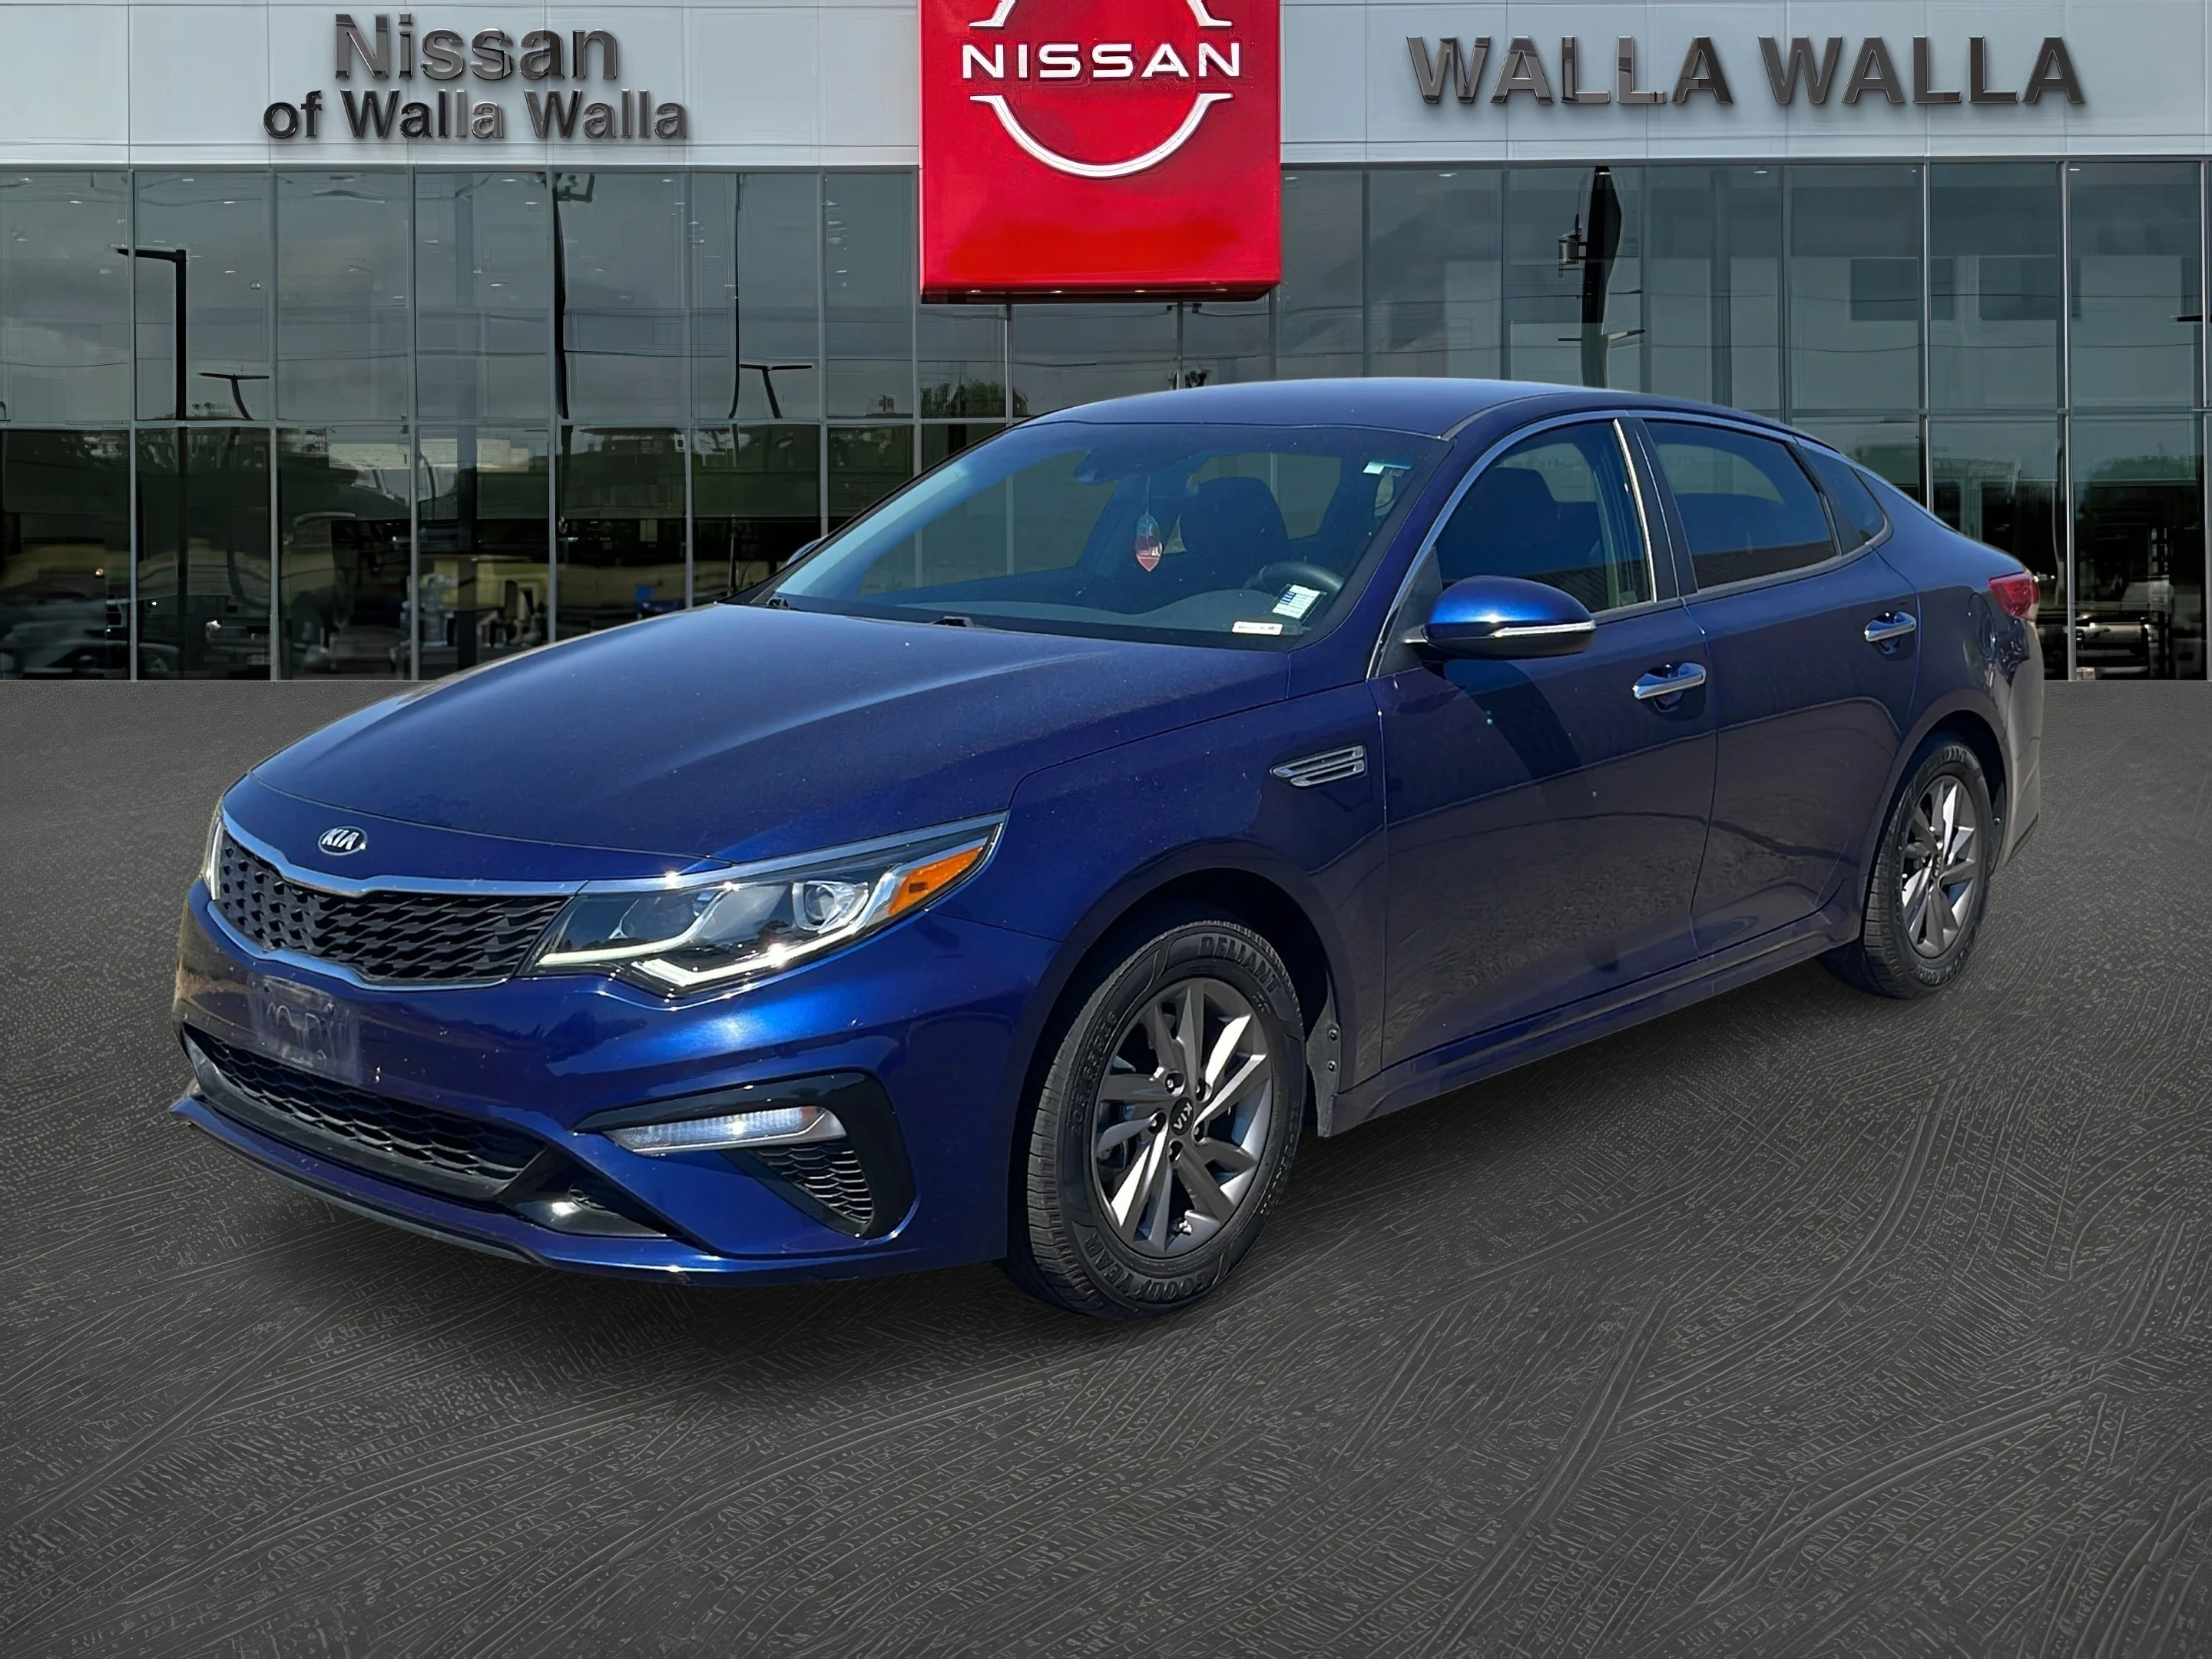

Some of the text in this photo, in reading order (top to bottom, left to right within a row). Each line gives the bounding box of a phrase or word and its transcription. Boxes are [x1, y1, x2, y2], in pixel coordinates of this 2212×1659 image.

[334, 13, 618, 80] Nissan
[962, 43, 1240, 78] NISSAN
[1406, 35, 2085, 105] WALLA WALLA
[263, 89, 687, 139] of Walla Walla
[321, 828, 359, 850] KIA
[1173, 1101, 1193, 1130] KIA
